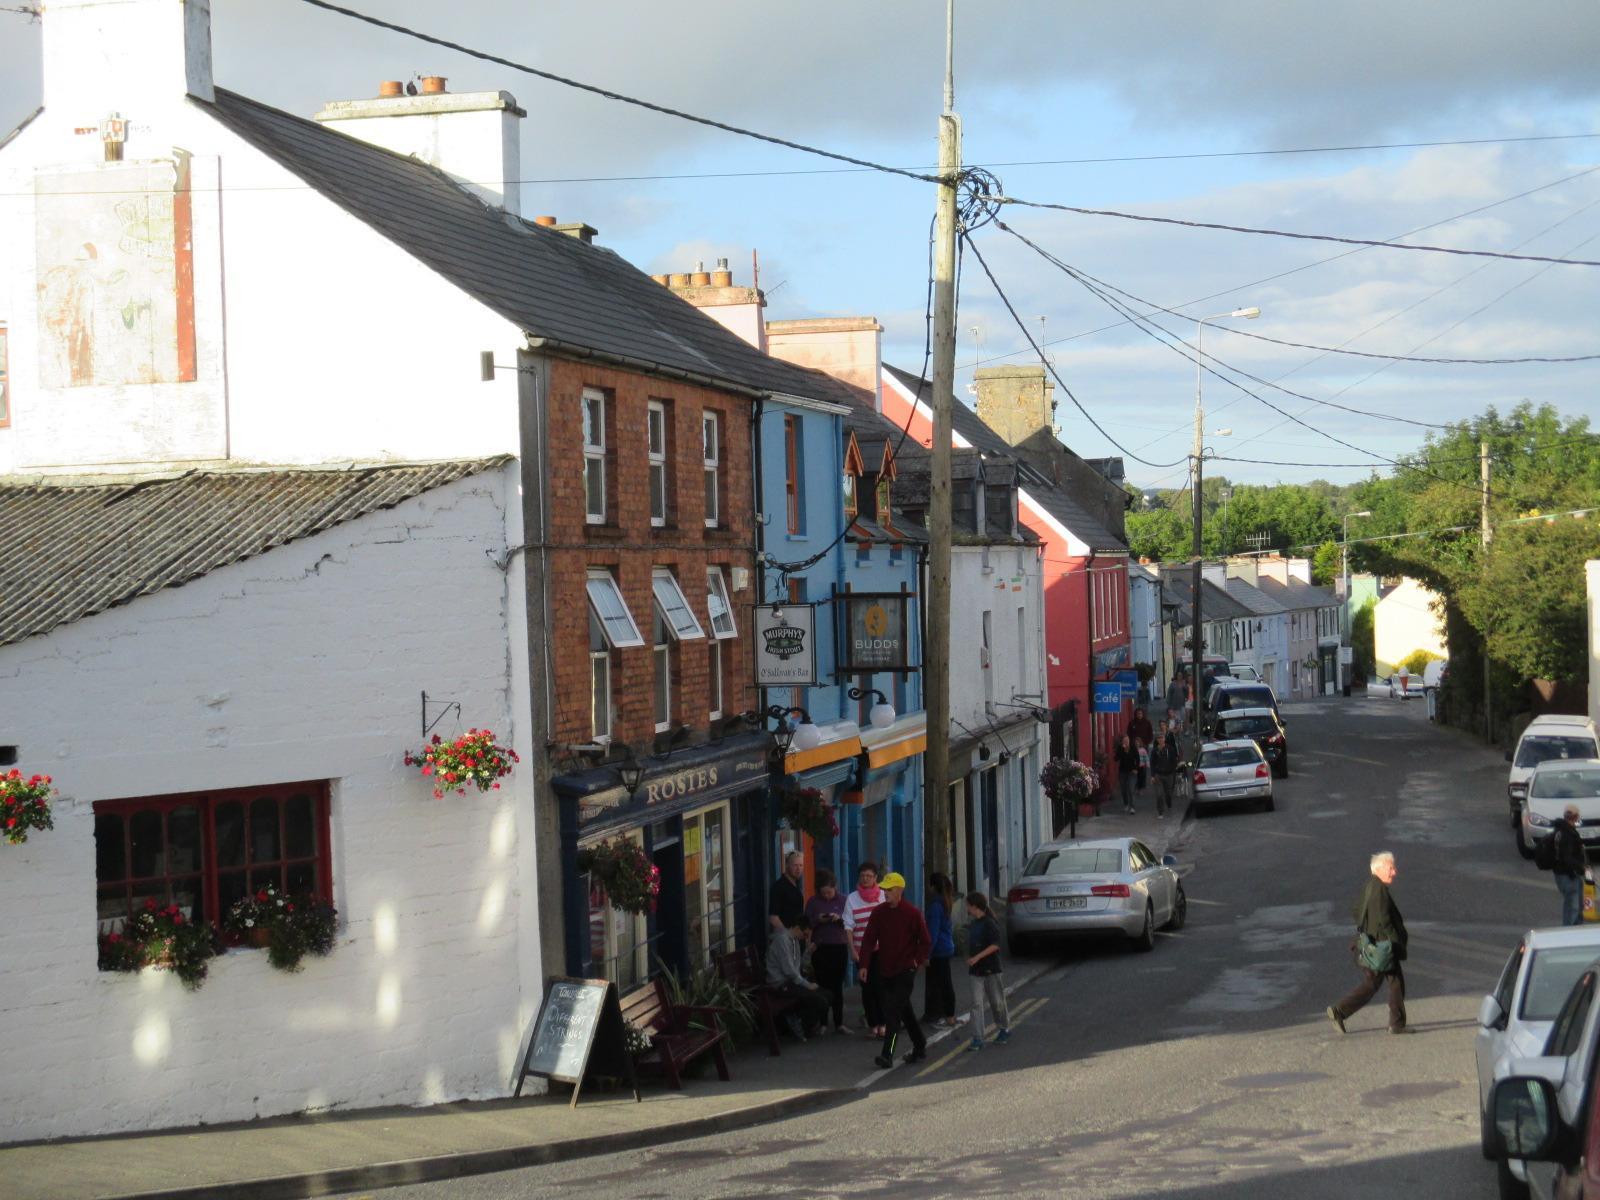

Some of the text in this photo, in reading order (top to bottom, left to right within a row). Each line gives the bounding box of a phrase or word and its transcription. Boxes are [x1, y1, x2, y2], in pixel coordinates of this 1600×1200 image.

[797, 667, 809, 677] Bar
[1094, 691, 1119, 703] Café
[646, 767, 718, 804] ROSIES
